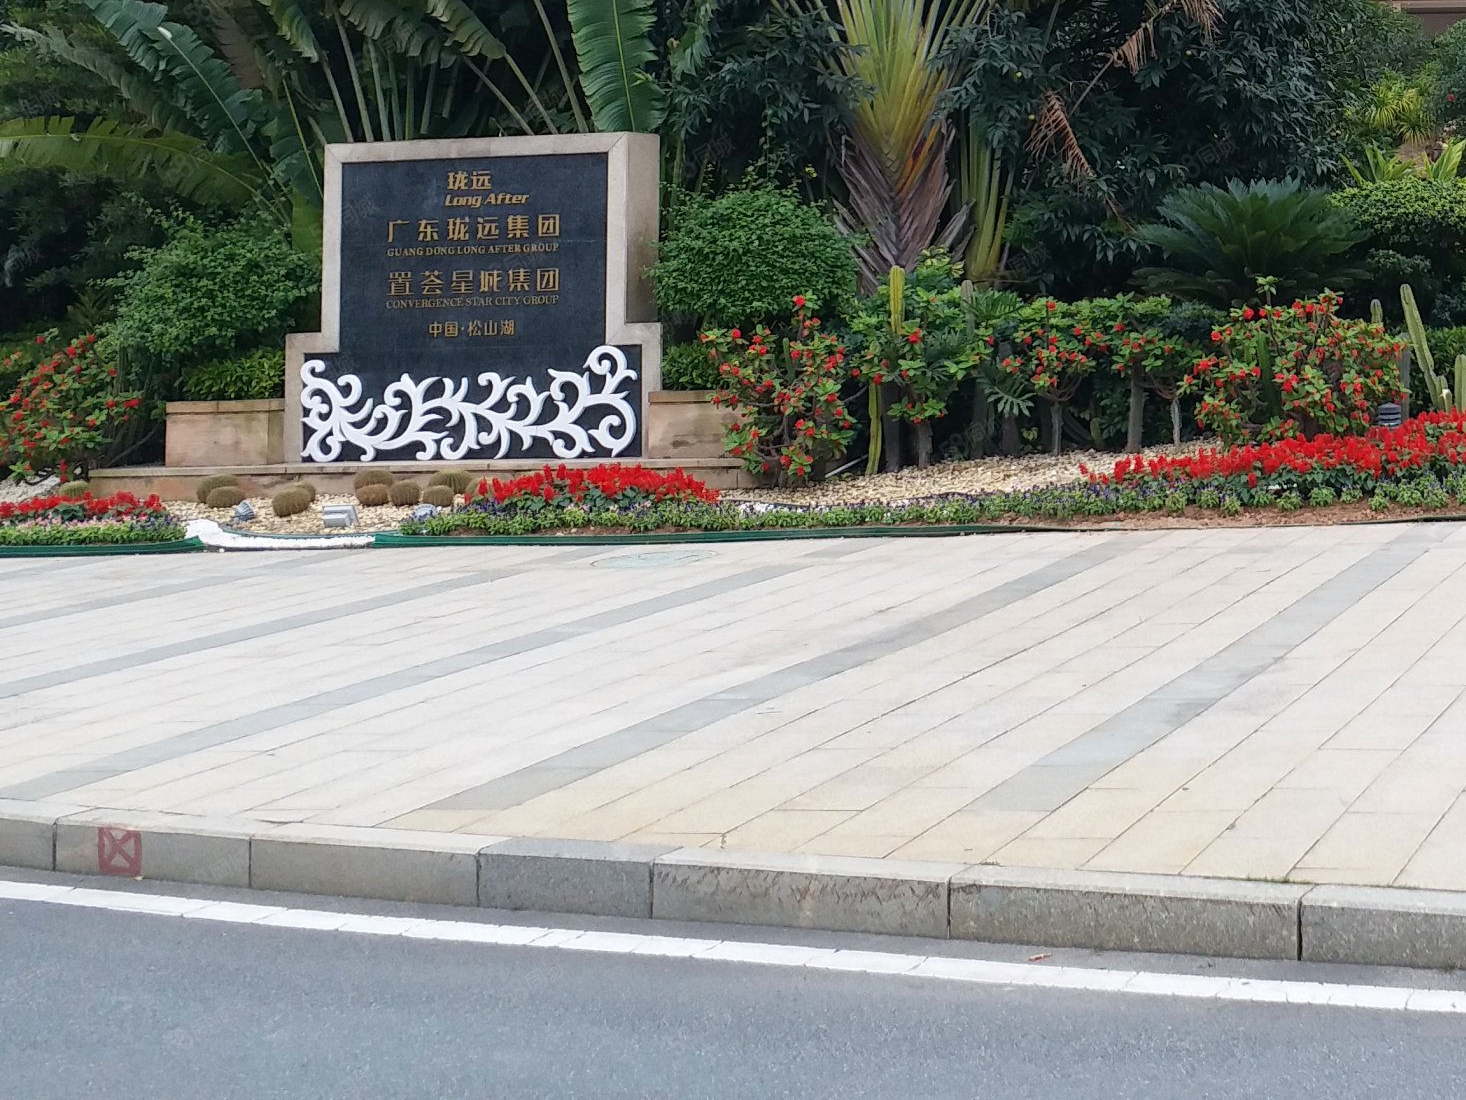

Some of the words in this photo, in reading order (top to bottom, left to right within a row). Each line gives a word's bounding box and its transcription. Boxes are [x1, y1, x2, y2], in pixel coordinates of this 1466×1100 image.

[447, 171, 492, 190] 珑远
[444, 194, 483, 209] Long
[483, 192, 530, 205] After
[387, 214, 560, 243] 广东珑远集团
[387, 247, 424, 257] GUANG
[425, 246, 456, 256] DONG
[457, 245, 486, 255] LONG
[488, 244, 521, 254] AFTER
[522, 243, 559, 253] GROUP
[386, 267, 560, 296] 置荟星城集团
[386, 298, 464, 309] CONVERGENCE
[465, 297, 492, 307] STAR
[495, 296, 522, 306] CITY
[523, 295, 560, 305] GROUP
